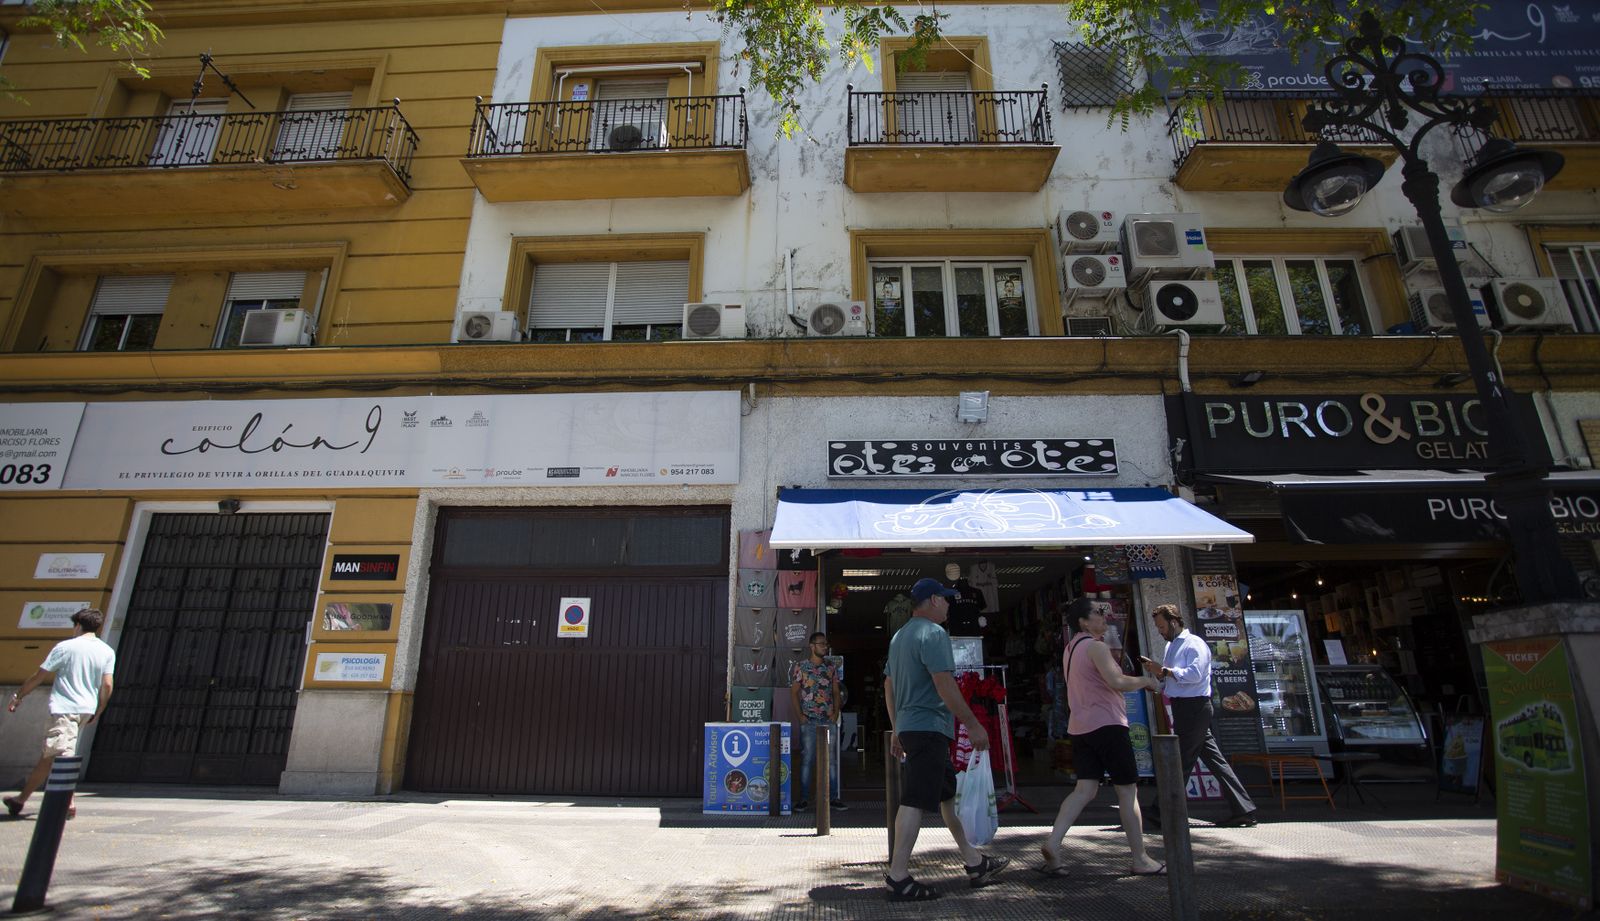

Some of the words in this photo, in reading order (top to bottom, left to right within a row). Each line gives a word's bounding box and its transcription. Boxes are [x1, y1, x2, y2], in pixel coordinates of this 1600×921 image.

[1527, 3, 1546, 43] 9
[1267, 73, 1328, 88] proube
[1204, 400, 1353, 439] PURO
[1359, 393, 1411, 445] &
[161, 412, 359, 455] colón
[360, 405, 382, 454] 9
[28, 438, 61, 446] FLORES
[911, 442, 1021, 452] souvenirs
[255, 470, 299, 478] ORILLAS
[326, 469, 406, 479] GUADALQUIVIR
[495, 467, 522, 476] proube
[341, 656, 381, 665] PSICOLOGÍA
[1505, 653, 1540, 662] TICKET
[708, 731, 719, 768] Advisor
[707, 770, 719, 805] Tourist
